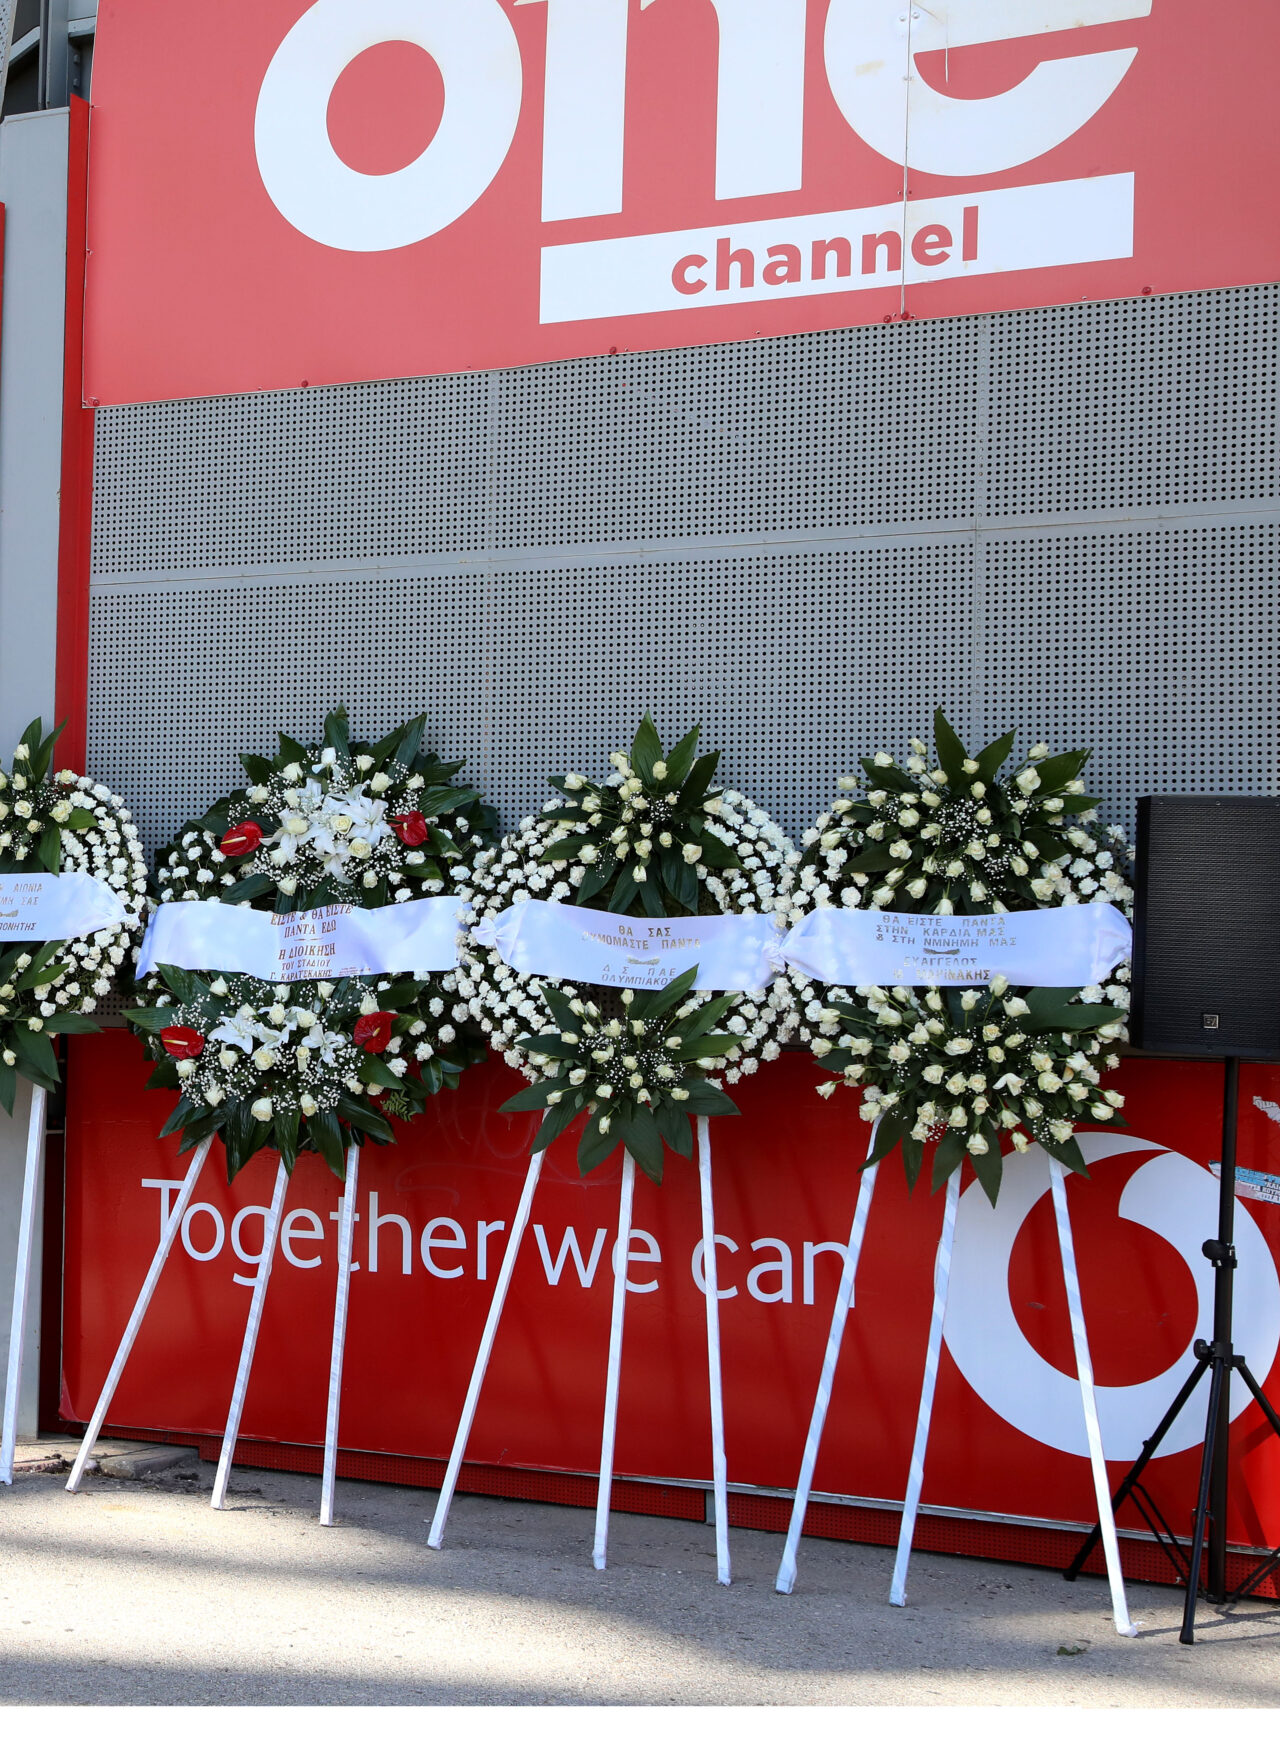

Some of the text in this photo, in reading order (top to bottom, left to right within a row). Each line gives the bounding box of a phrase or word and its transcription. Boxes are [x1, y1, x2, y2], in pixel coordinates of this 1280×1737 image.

[254, 0, 1151, 251] one
[671, 206, 979, 295] channel
[270, 911, 296, 926] ΕΙΣΤΕ
[311, 909, 324, 920] ΘΑ
[883, 915, 1006, 927] ΘΑ ΕΙΣΤΕ ΠΑΝΤΑ
[284, 920, 337, 938] ΠΑΝΤΑ ΕΔΩ
[619, 925, 671, 938] ΘΑ ΣΑΣ
[876, 925, 1005, 937] ΣΤΗΝ ΚΑΡΔΙΑ ΜΑΣ
[278, 943, 336, 960] Η ΔΙΟΙΚΗΣΗ
[282, 959, 331, 970] ΤΟΥ ΣΤΑΔΙΟΥ
[141, 1178, 855, 1309] Together we can
